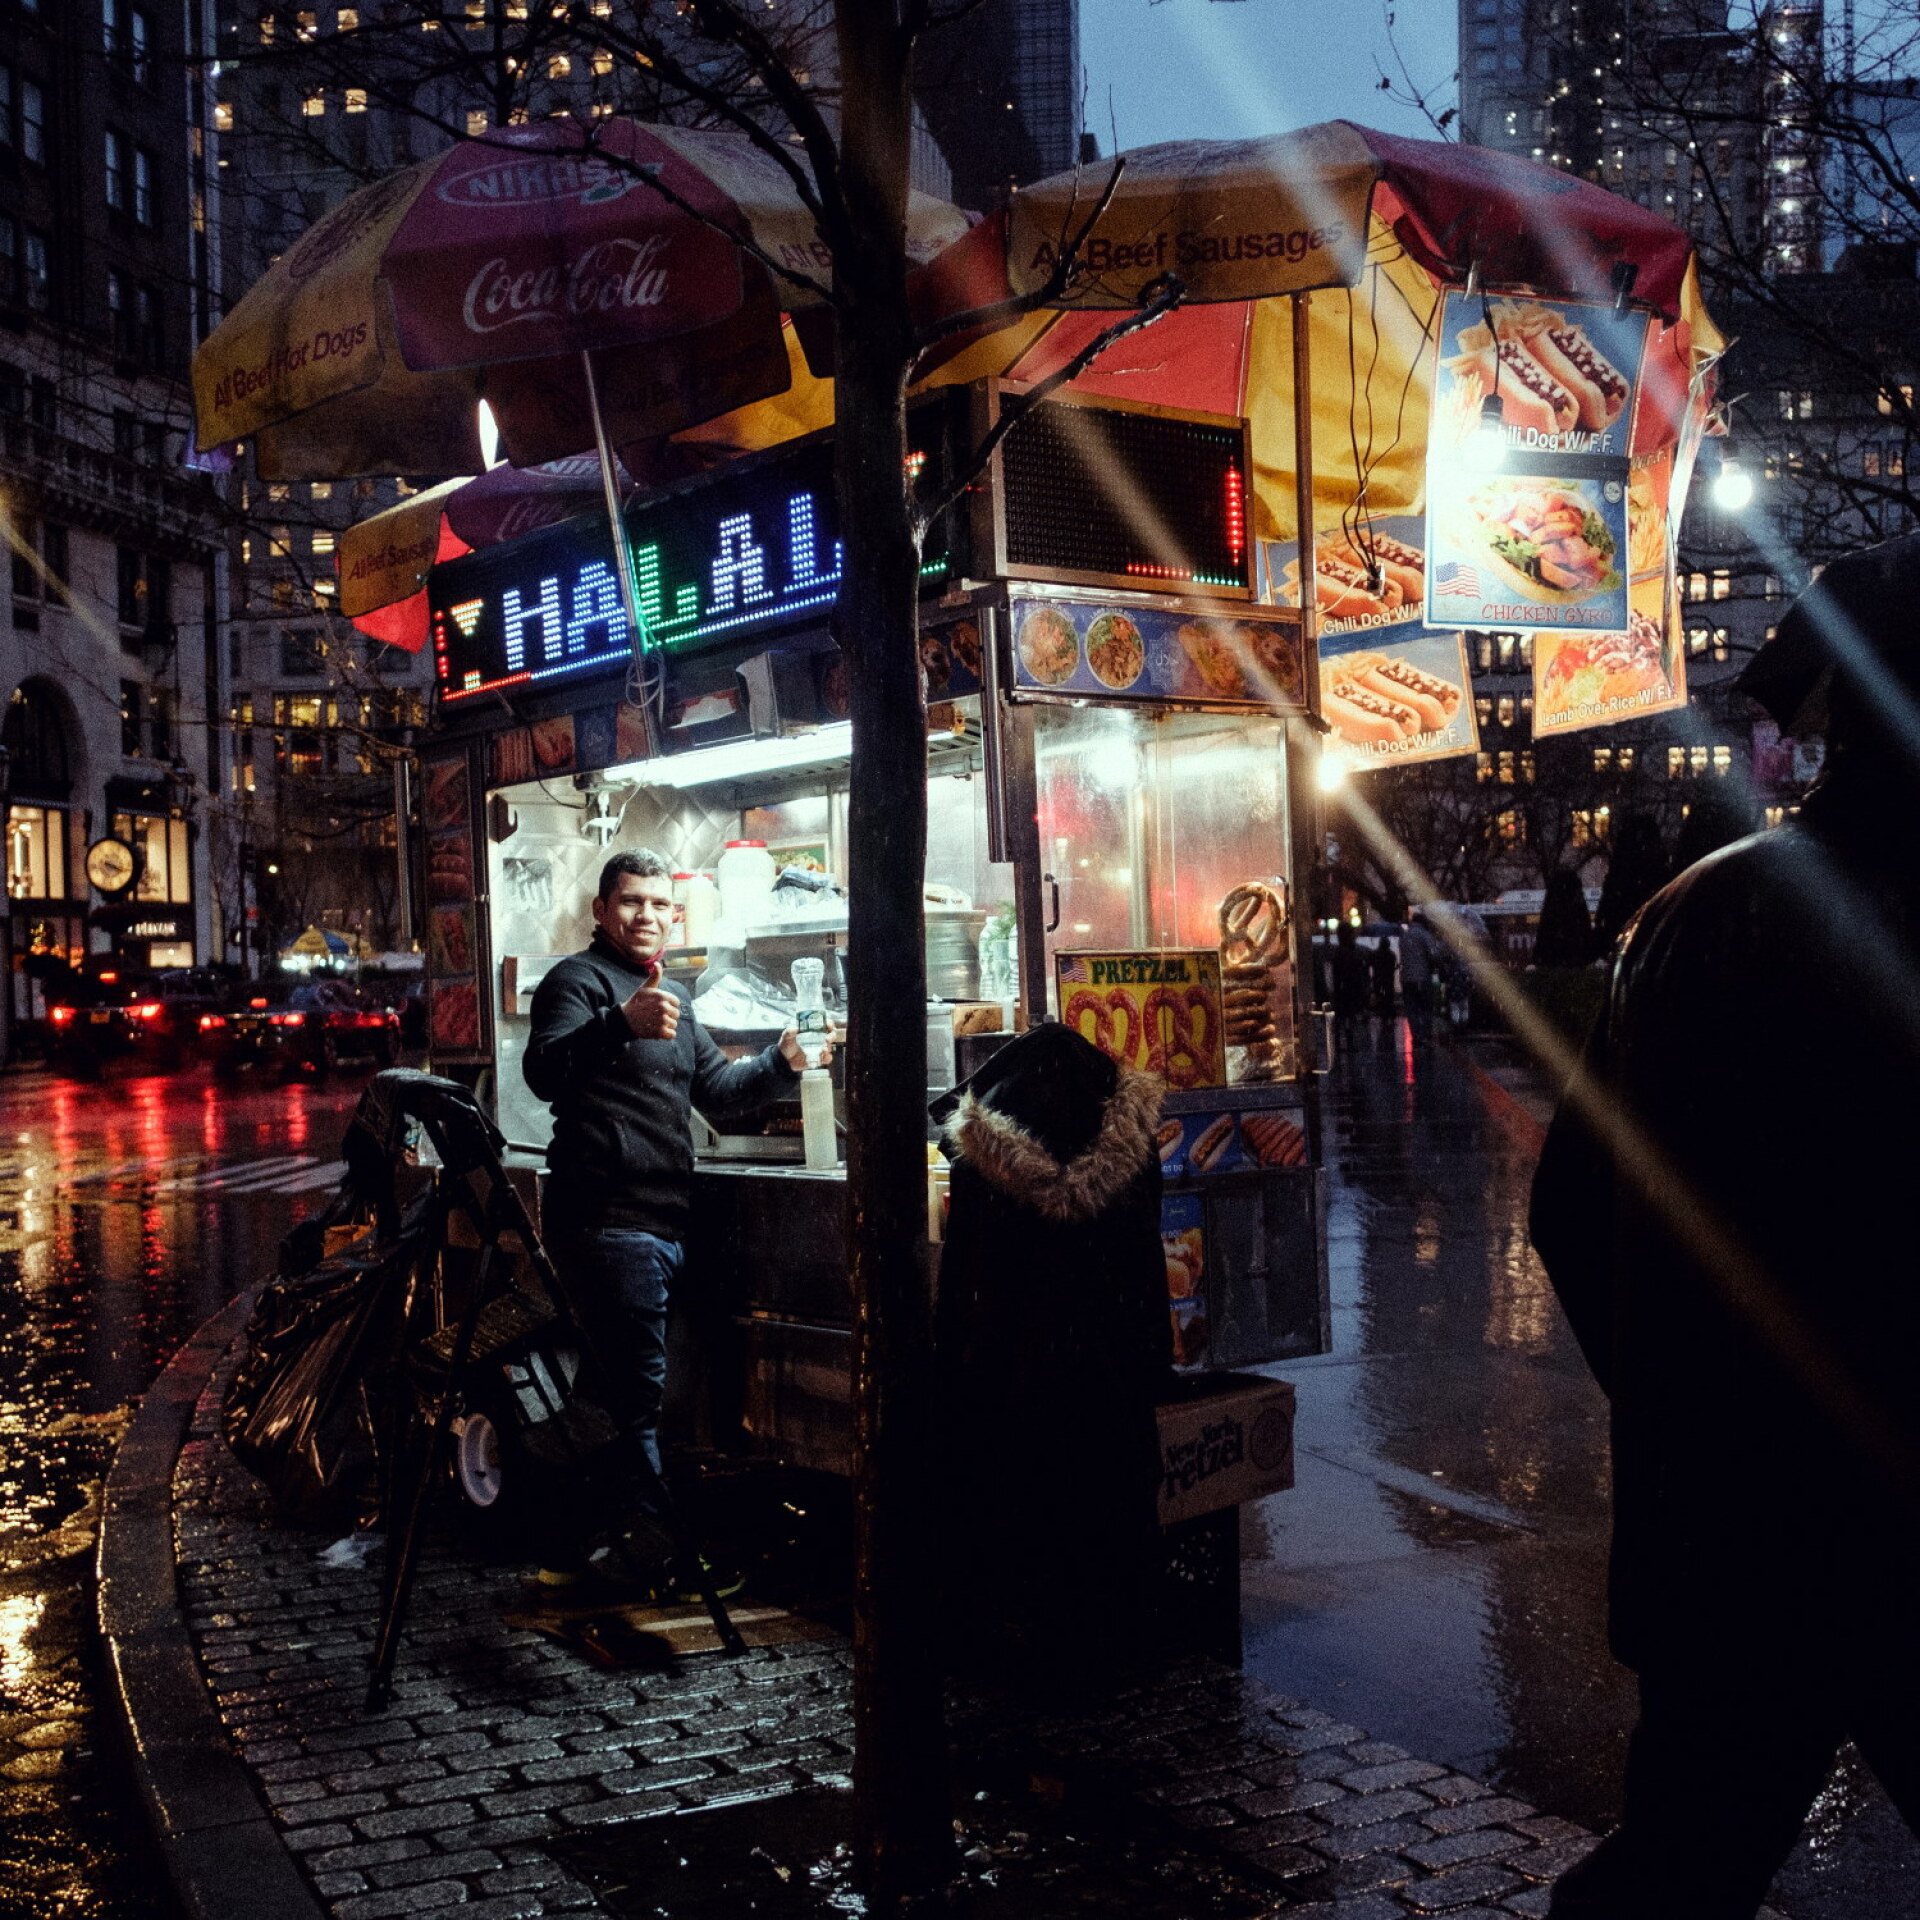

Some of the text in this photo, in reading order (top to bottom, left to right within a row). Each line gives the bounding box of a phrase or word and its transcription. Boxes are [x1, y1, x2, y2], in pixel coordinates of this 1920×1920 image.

[1087, 233, 1168, 270] Beef
[1175, 221, 1344, 265] Sausages
[213, 322, 367, 412] All Beef Hot Dogs
[1499, 424, 1615, 453] hili Dog W/ F.F.
[503, 493, 843, 671] HALAL
[1324, 615, 1358, 634] Chili
[1361, 611, 1391, 628] Dog
[1481, 603, 1615, 624] CHICKEN GYRO
[1543, 707, 1575, 727] Lamb
[1578, 702, 1606, 719] Over
[1609, 695, 1635, 713] Rice
[1378, 738, 1409, 755] Dog
[1091, 958, 1190, 984] PRETZEL
[1162, 1421, 1244, 1498] retzel
